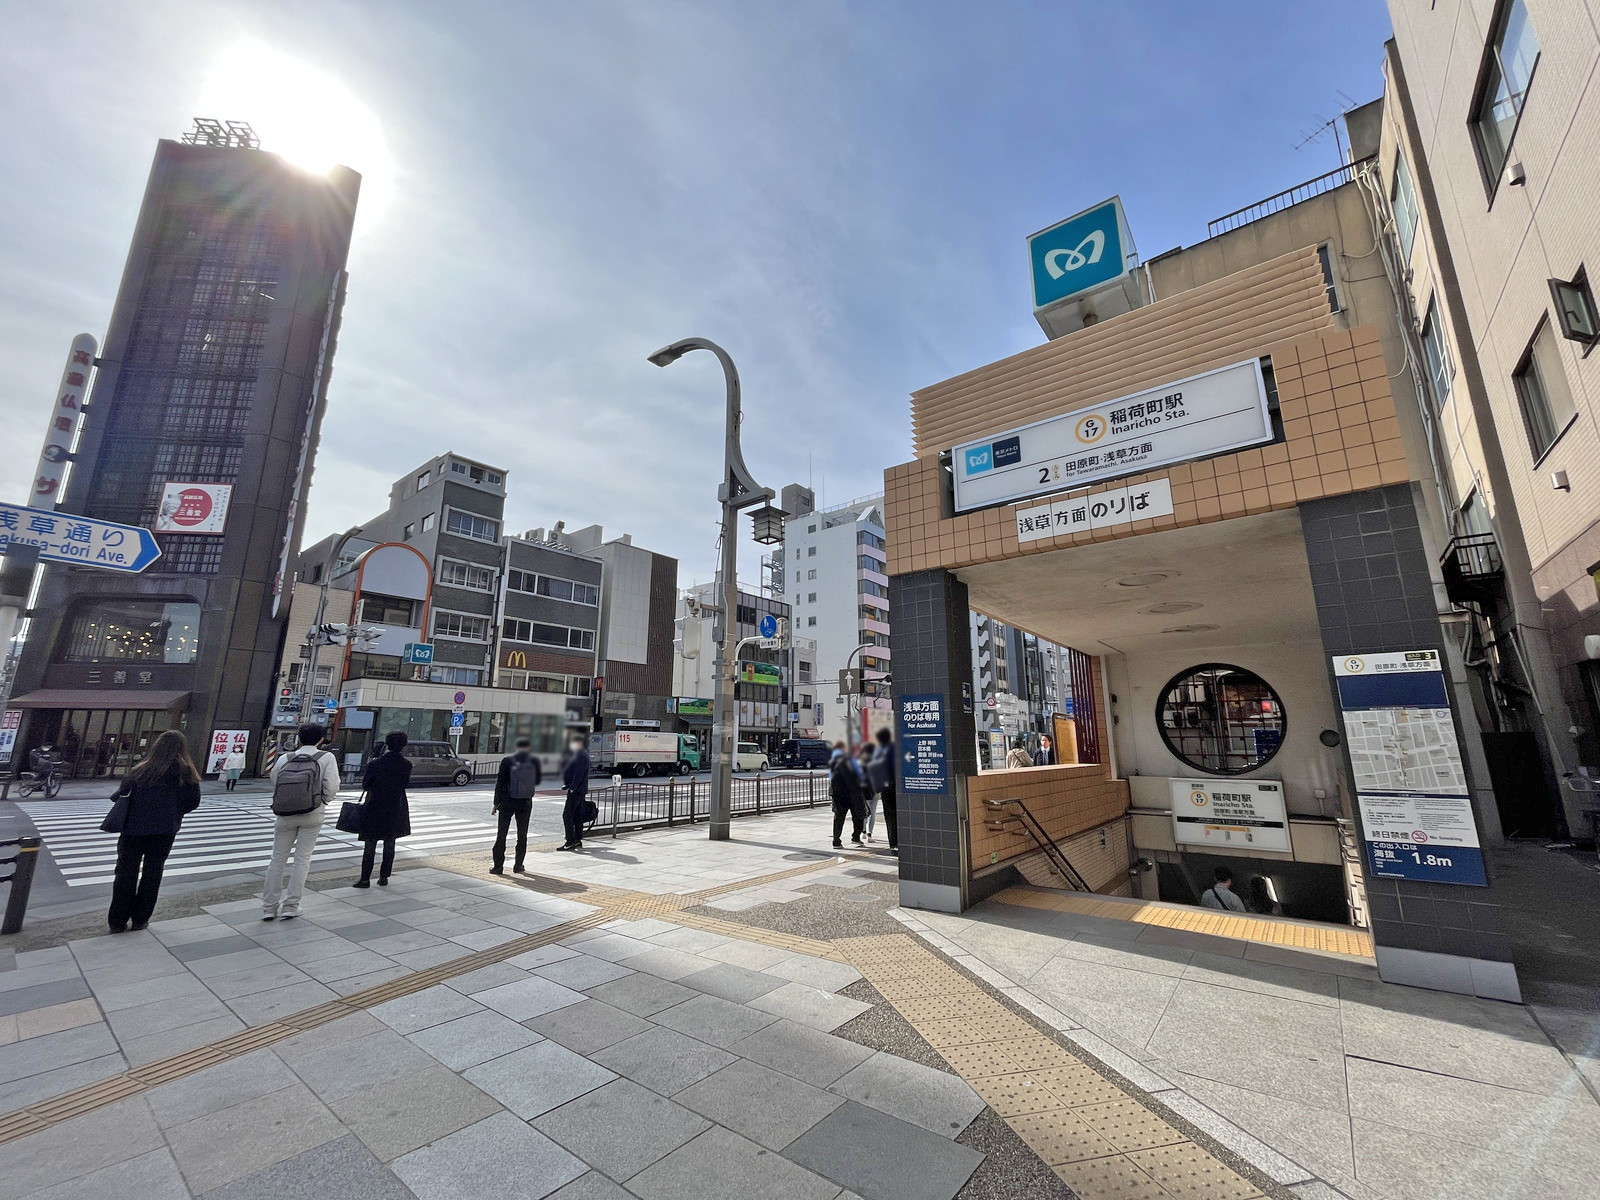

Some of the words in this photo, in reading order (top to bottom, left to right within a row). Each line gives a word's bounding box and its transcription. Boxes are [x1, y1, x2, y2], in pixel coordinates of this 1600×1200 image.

[1110, 392, 1184, 425] 稲荷町駅
[1086, 420, 1095, 428] G
[1112, 416, 1161, 435] Inaricho
[1165, 410, 1190, 421] Sta.
[1085, 427, 1098, 438] 17
[1077, 462, 1118, 475] Tawaramachi,
[1120, 454, 1147, 465] Asakusa
[1039, 467, 1051, 484] 2
[1019, 491, 1150, 534] 浅草方面のりば
[96, 547, 128, 565] Ave.
[86, 671, 153, 684] 三善堂
[903, 701, 939, 712] 浅草方面
[903, 712, 940, 721] のりば専用
[212, 733, 228, 754] 位牌
[619, 734, 631, 743] 115
[1212, 793, 1252, 803] 稲荷町駅
[1371, 830, 1410, 840] 終日禁煙
[1372, 842, 1418, 851] この出入口は
[1373, 849, 1396, 858] 海抜
[1411, 852, 1453, 867] 1.8m
